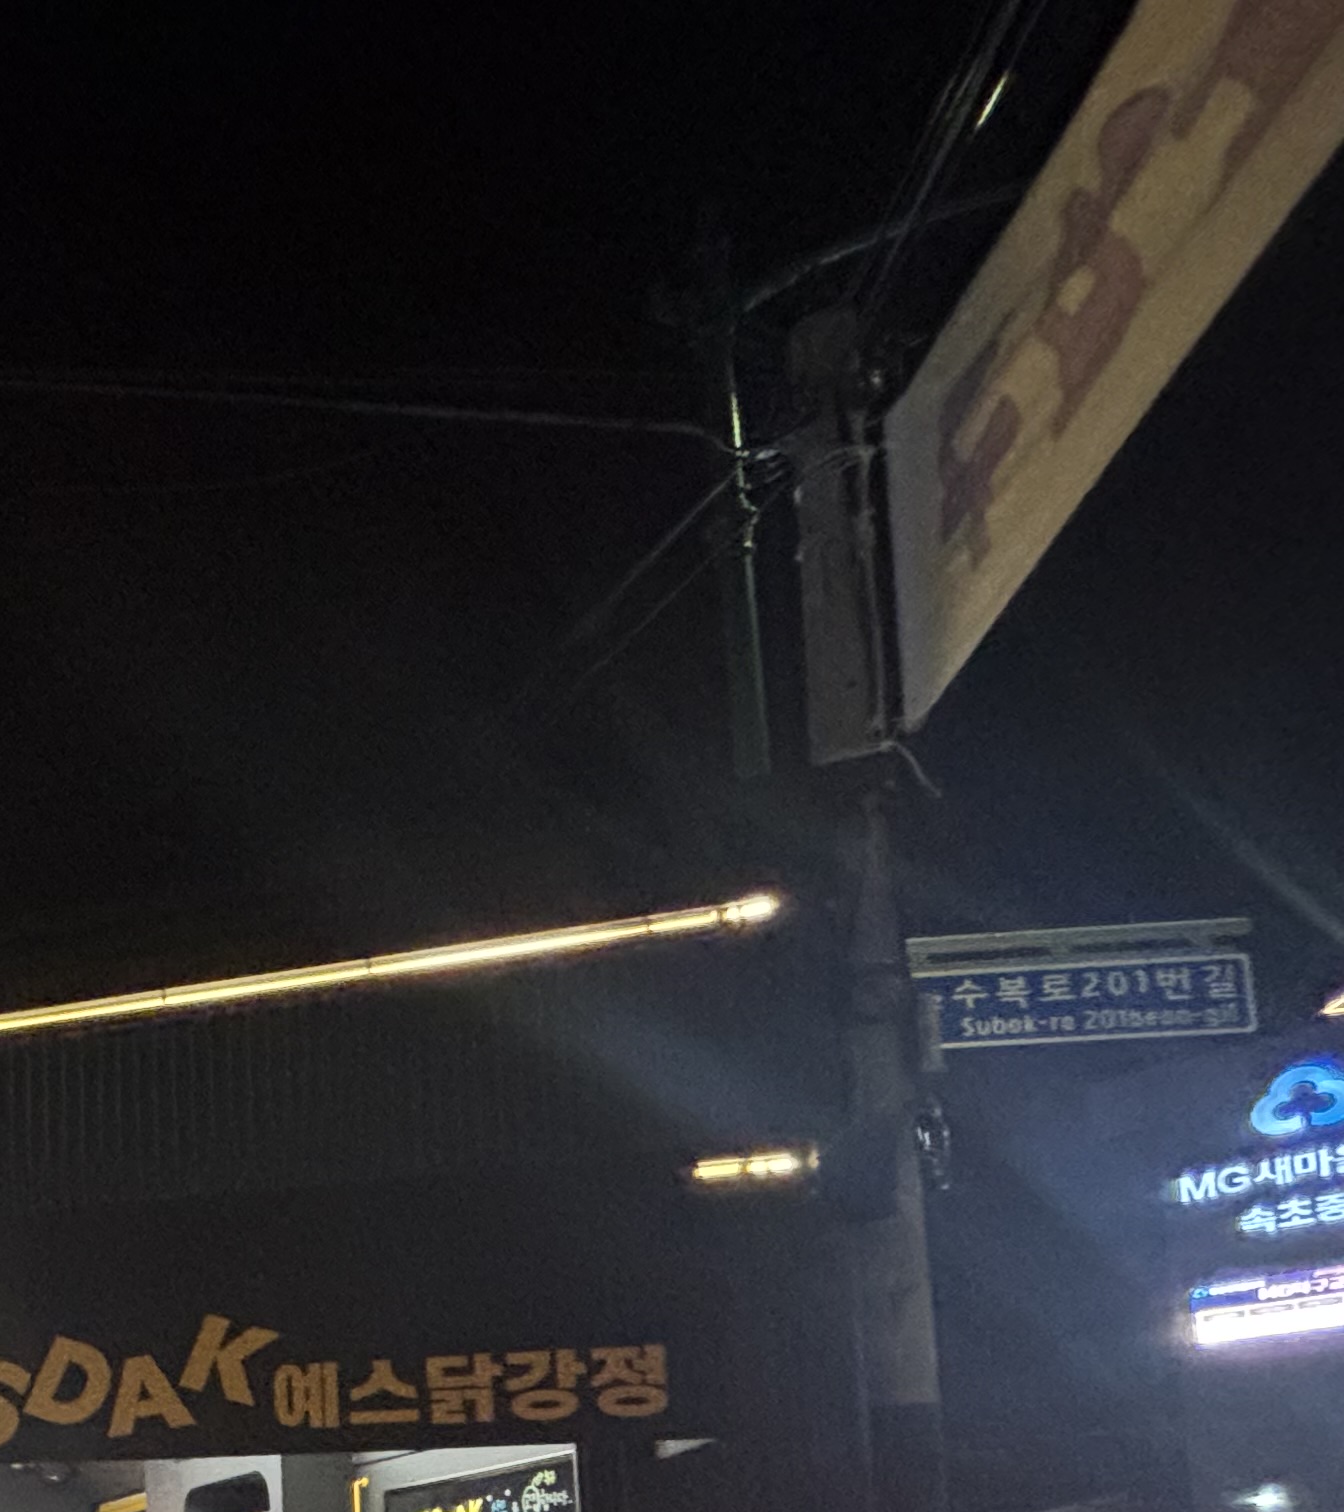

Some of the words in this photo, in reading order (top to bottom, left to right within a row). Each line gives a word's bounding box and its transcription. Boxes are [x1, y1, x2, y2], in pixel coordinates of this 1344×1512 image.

[952, 964, 1237, 1009] 수복로201번길
[962, 1015, 1075, 1036] Subok-ro
[273, 1343, 669, 1430] 예스닭강정
